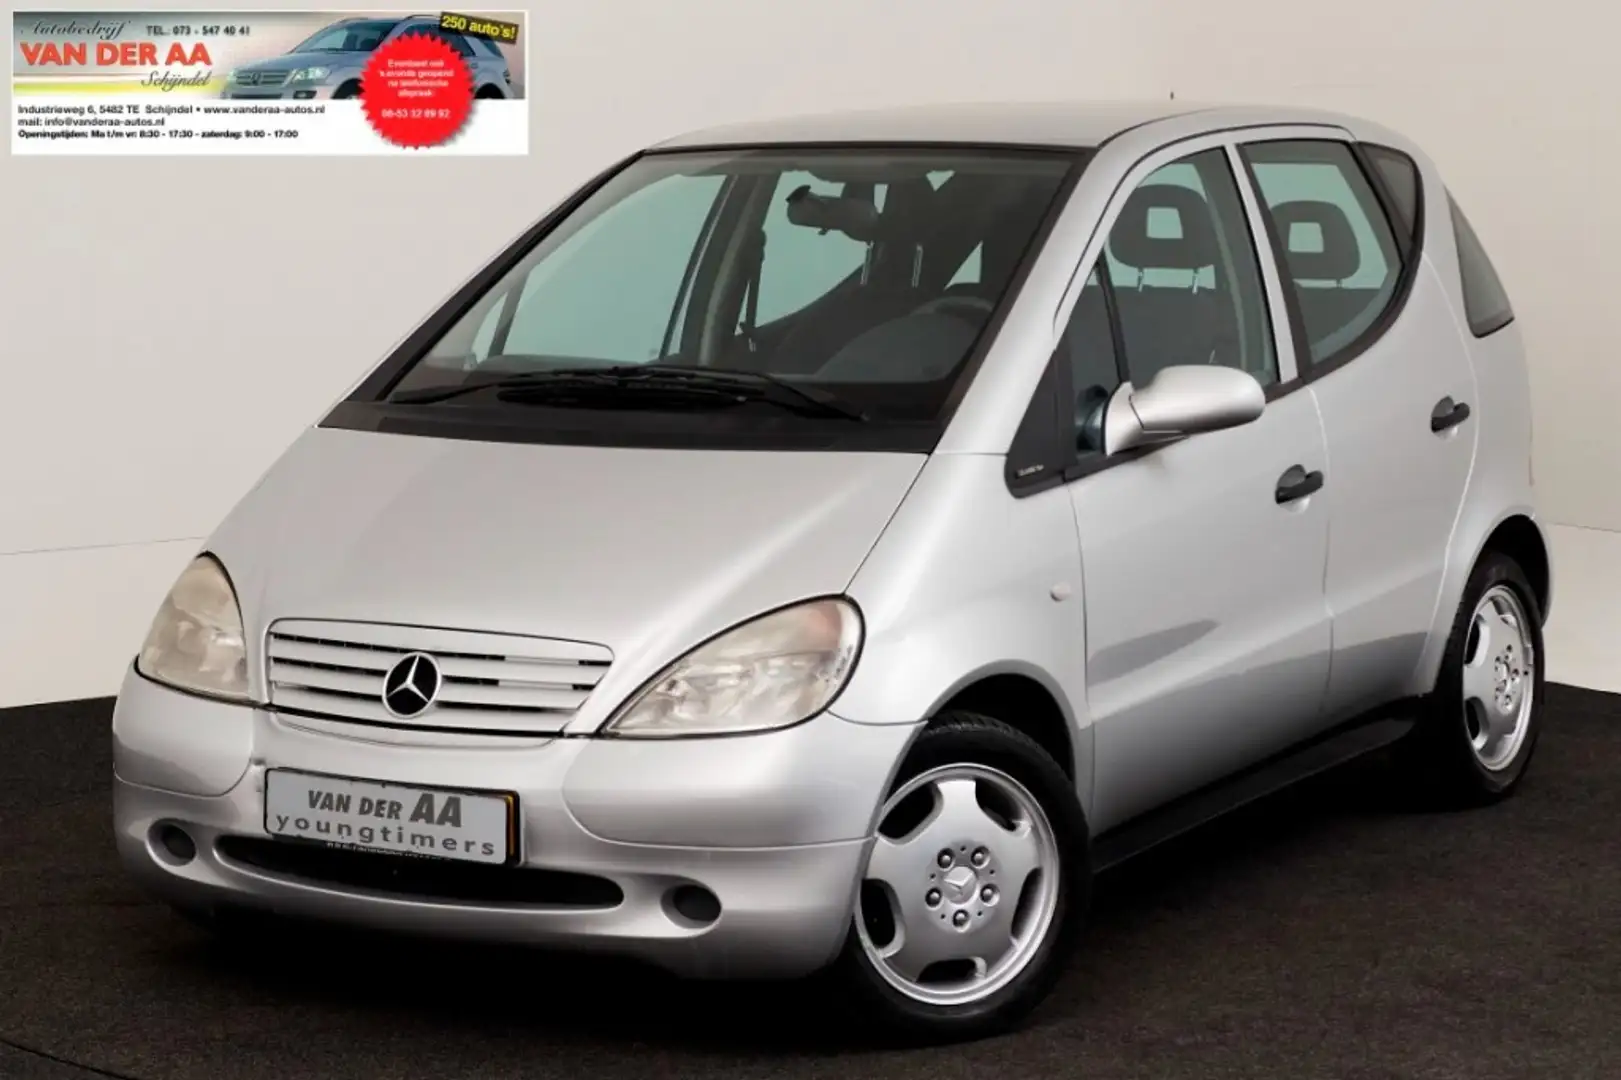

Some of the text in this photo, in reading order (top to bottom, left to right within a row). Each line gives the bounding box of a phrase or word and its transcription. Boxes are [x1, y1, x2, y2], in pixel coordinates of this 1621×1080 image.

[308, 790, 462, 828] VAN DER AA
[276, 813, 496, 857] youngtimers
